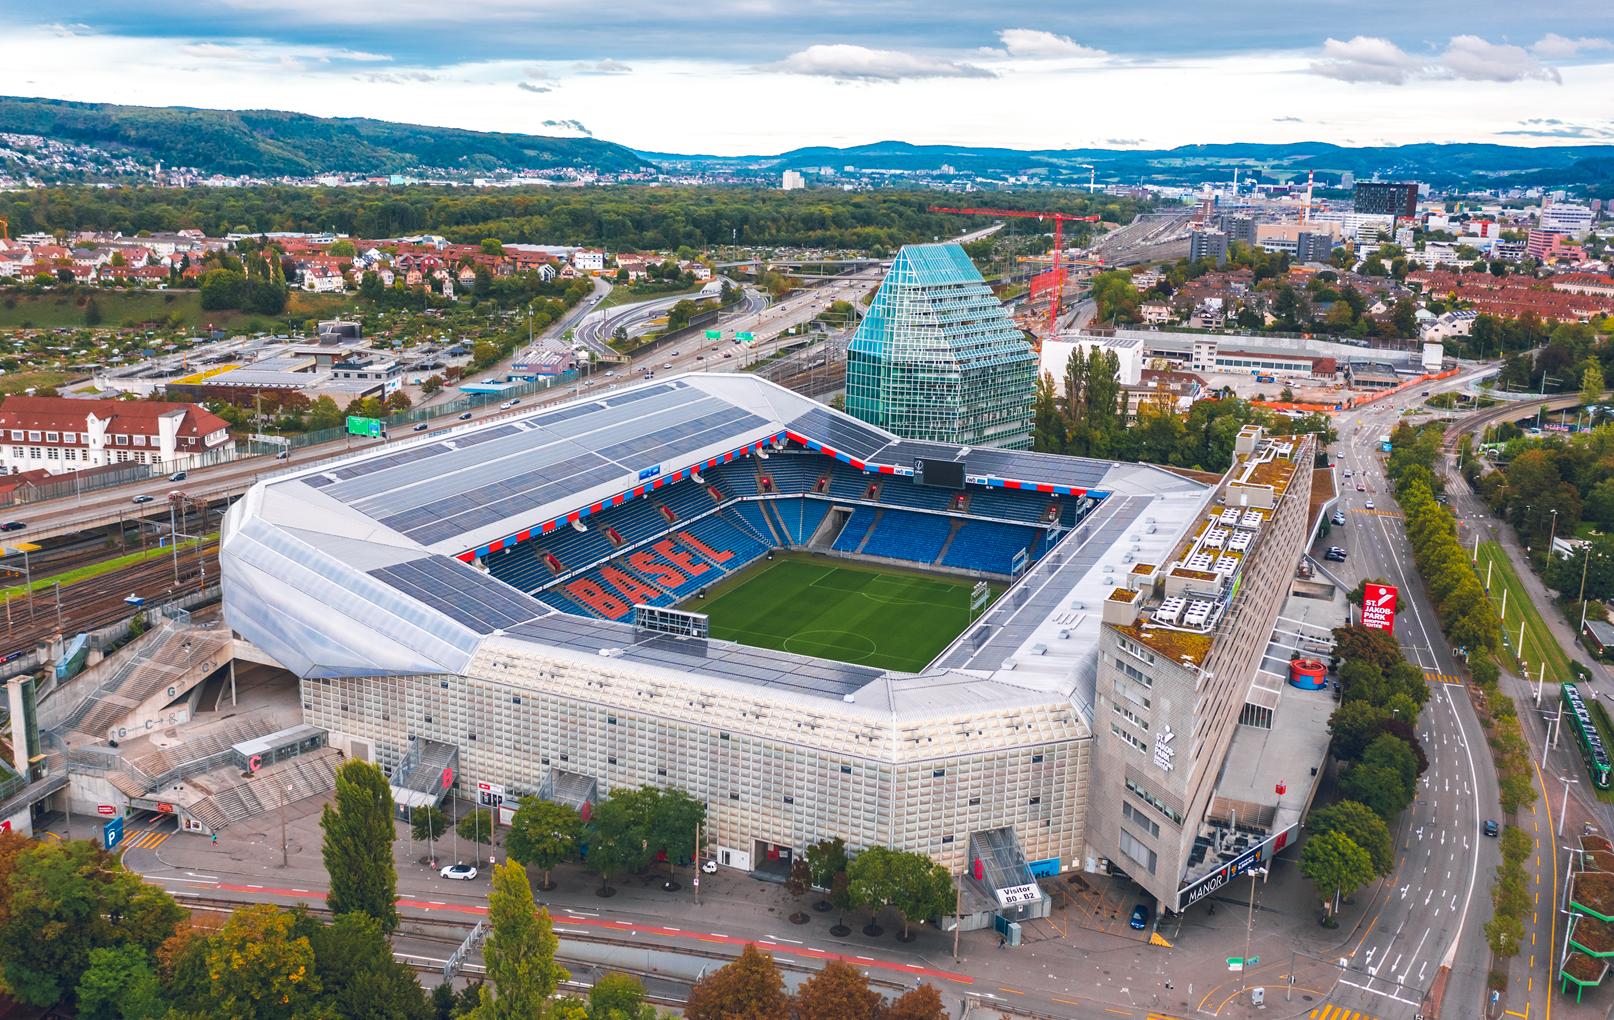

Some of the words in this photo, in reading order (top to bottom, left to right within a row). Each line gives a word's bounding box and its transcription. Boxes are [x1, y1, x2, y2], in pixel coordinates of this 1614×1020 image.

[565, 531, 737, 620] BASEL
[1364, 612, 1386, 620] PARK
[1365, 606, 1393, 615] JAKOB-
[168, 687, 175, 696] G
[1155, 746, 1170, 762] PARK
[249, 754, 261, 771] C
[108, 831, 115, 845] P
[1004, 886, 1030, 896] Visitor
[1189, 875, 1222, 903] MANOR
[1023, 892, 1035, 900] B2
